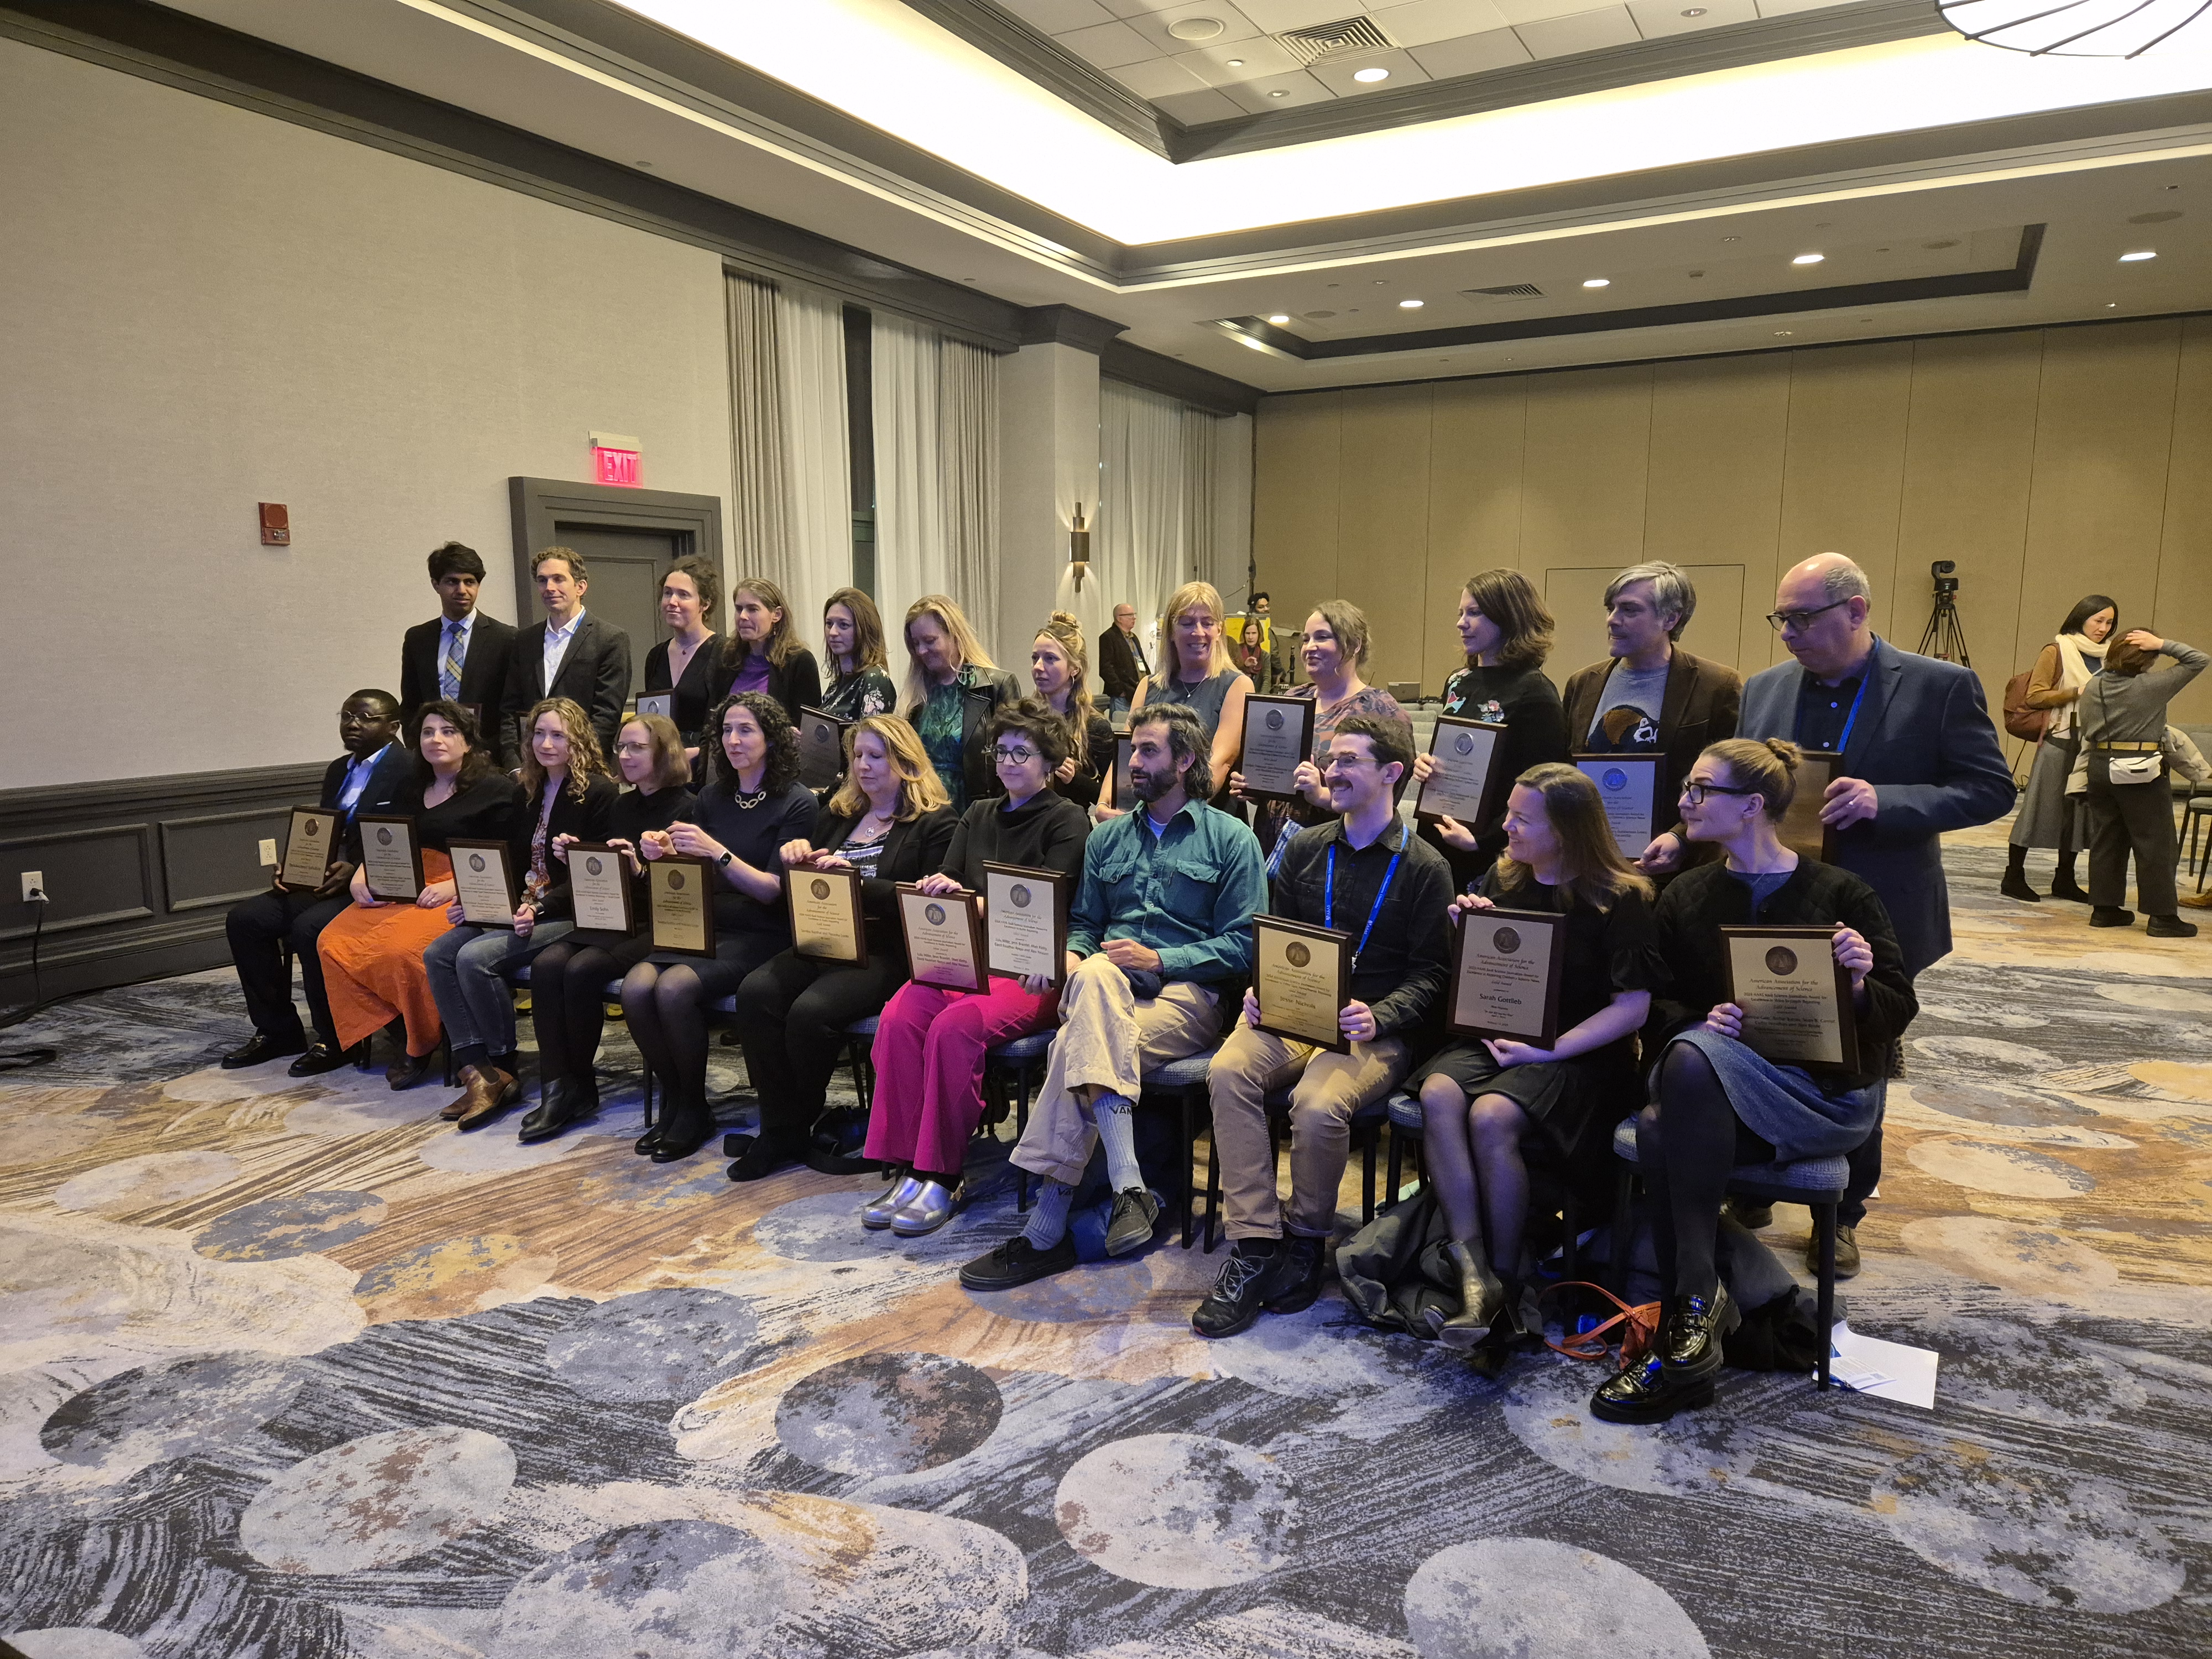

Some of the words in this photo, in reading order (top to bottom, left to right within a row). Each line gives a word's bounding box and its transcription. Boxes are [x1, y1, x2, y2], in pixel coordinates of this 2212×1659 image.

[603, 451, 637, 483] EXIT
[1296, 1000, 1316, 1009] Nichols
[1498, 996, 1522, 1005] Gottlieb
